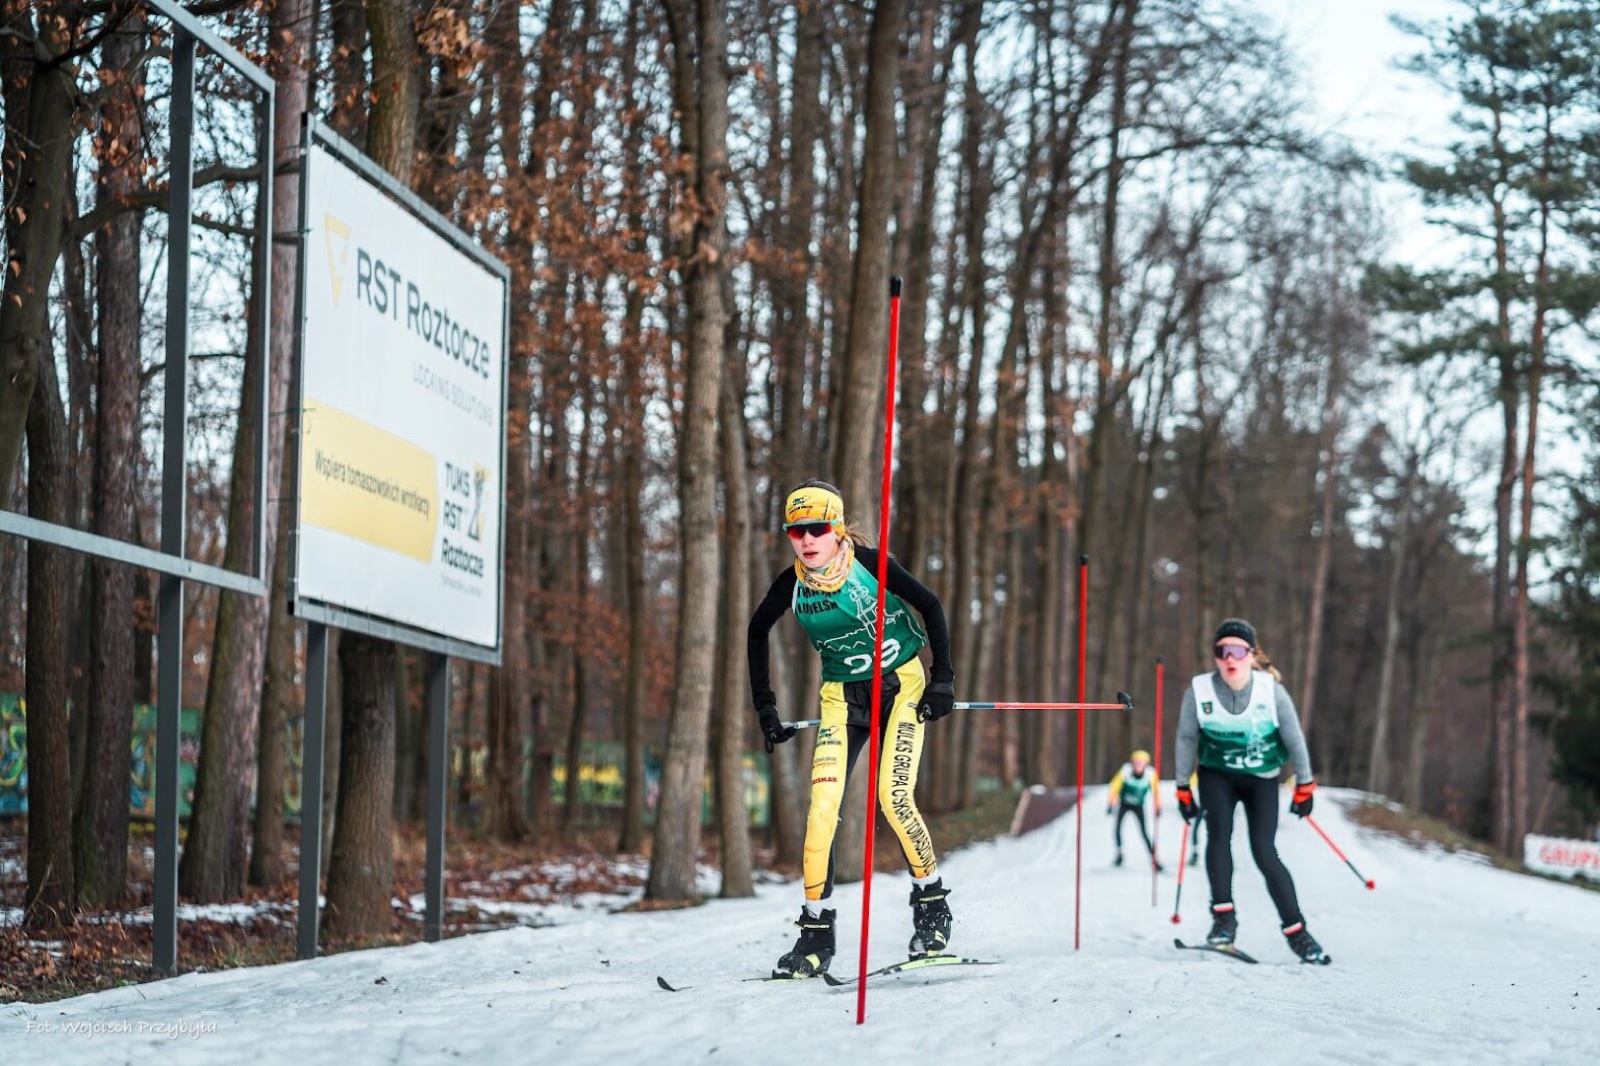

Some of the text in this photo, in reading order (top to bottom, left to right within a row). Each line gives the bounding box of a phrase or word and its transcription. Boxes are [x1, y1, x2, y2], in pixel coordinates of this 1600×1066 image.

[357, 248, 490, 380] RST Roztocze
[412, 361, 493, 427] LOCKING SOLUTIONS
[315, 448, 346, 483] Wspiera
[444, 460, 471, 498] TUKS
[443, 500, 463, 531] RST
[441, 537, 484, 578] Roztocze
[895, 721, 916, 755] MULKS
[891, 753, 912, 788] GRUPA
[891, 788, 914, 825] OSKAR
